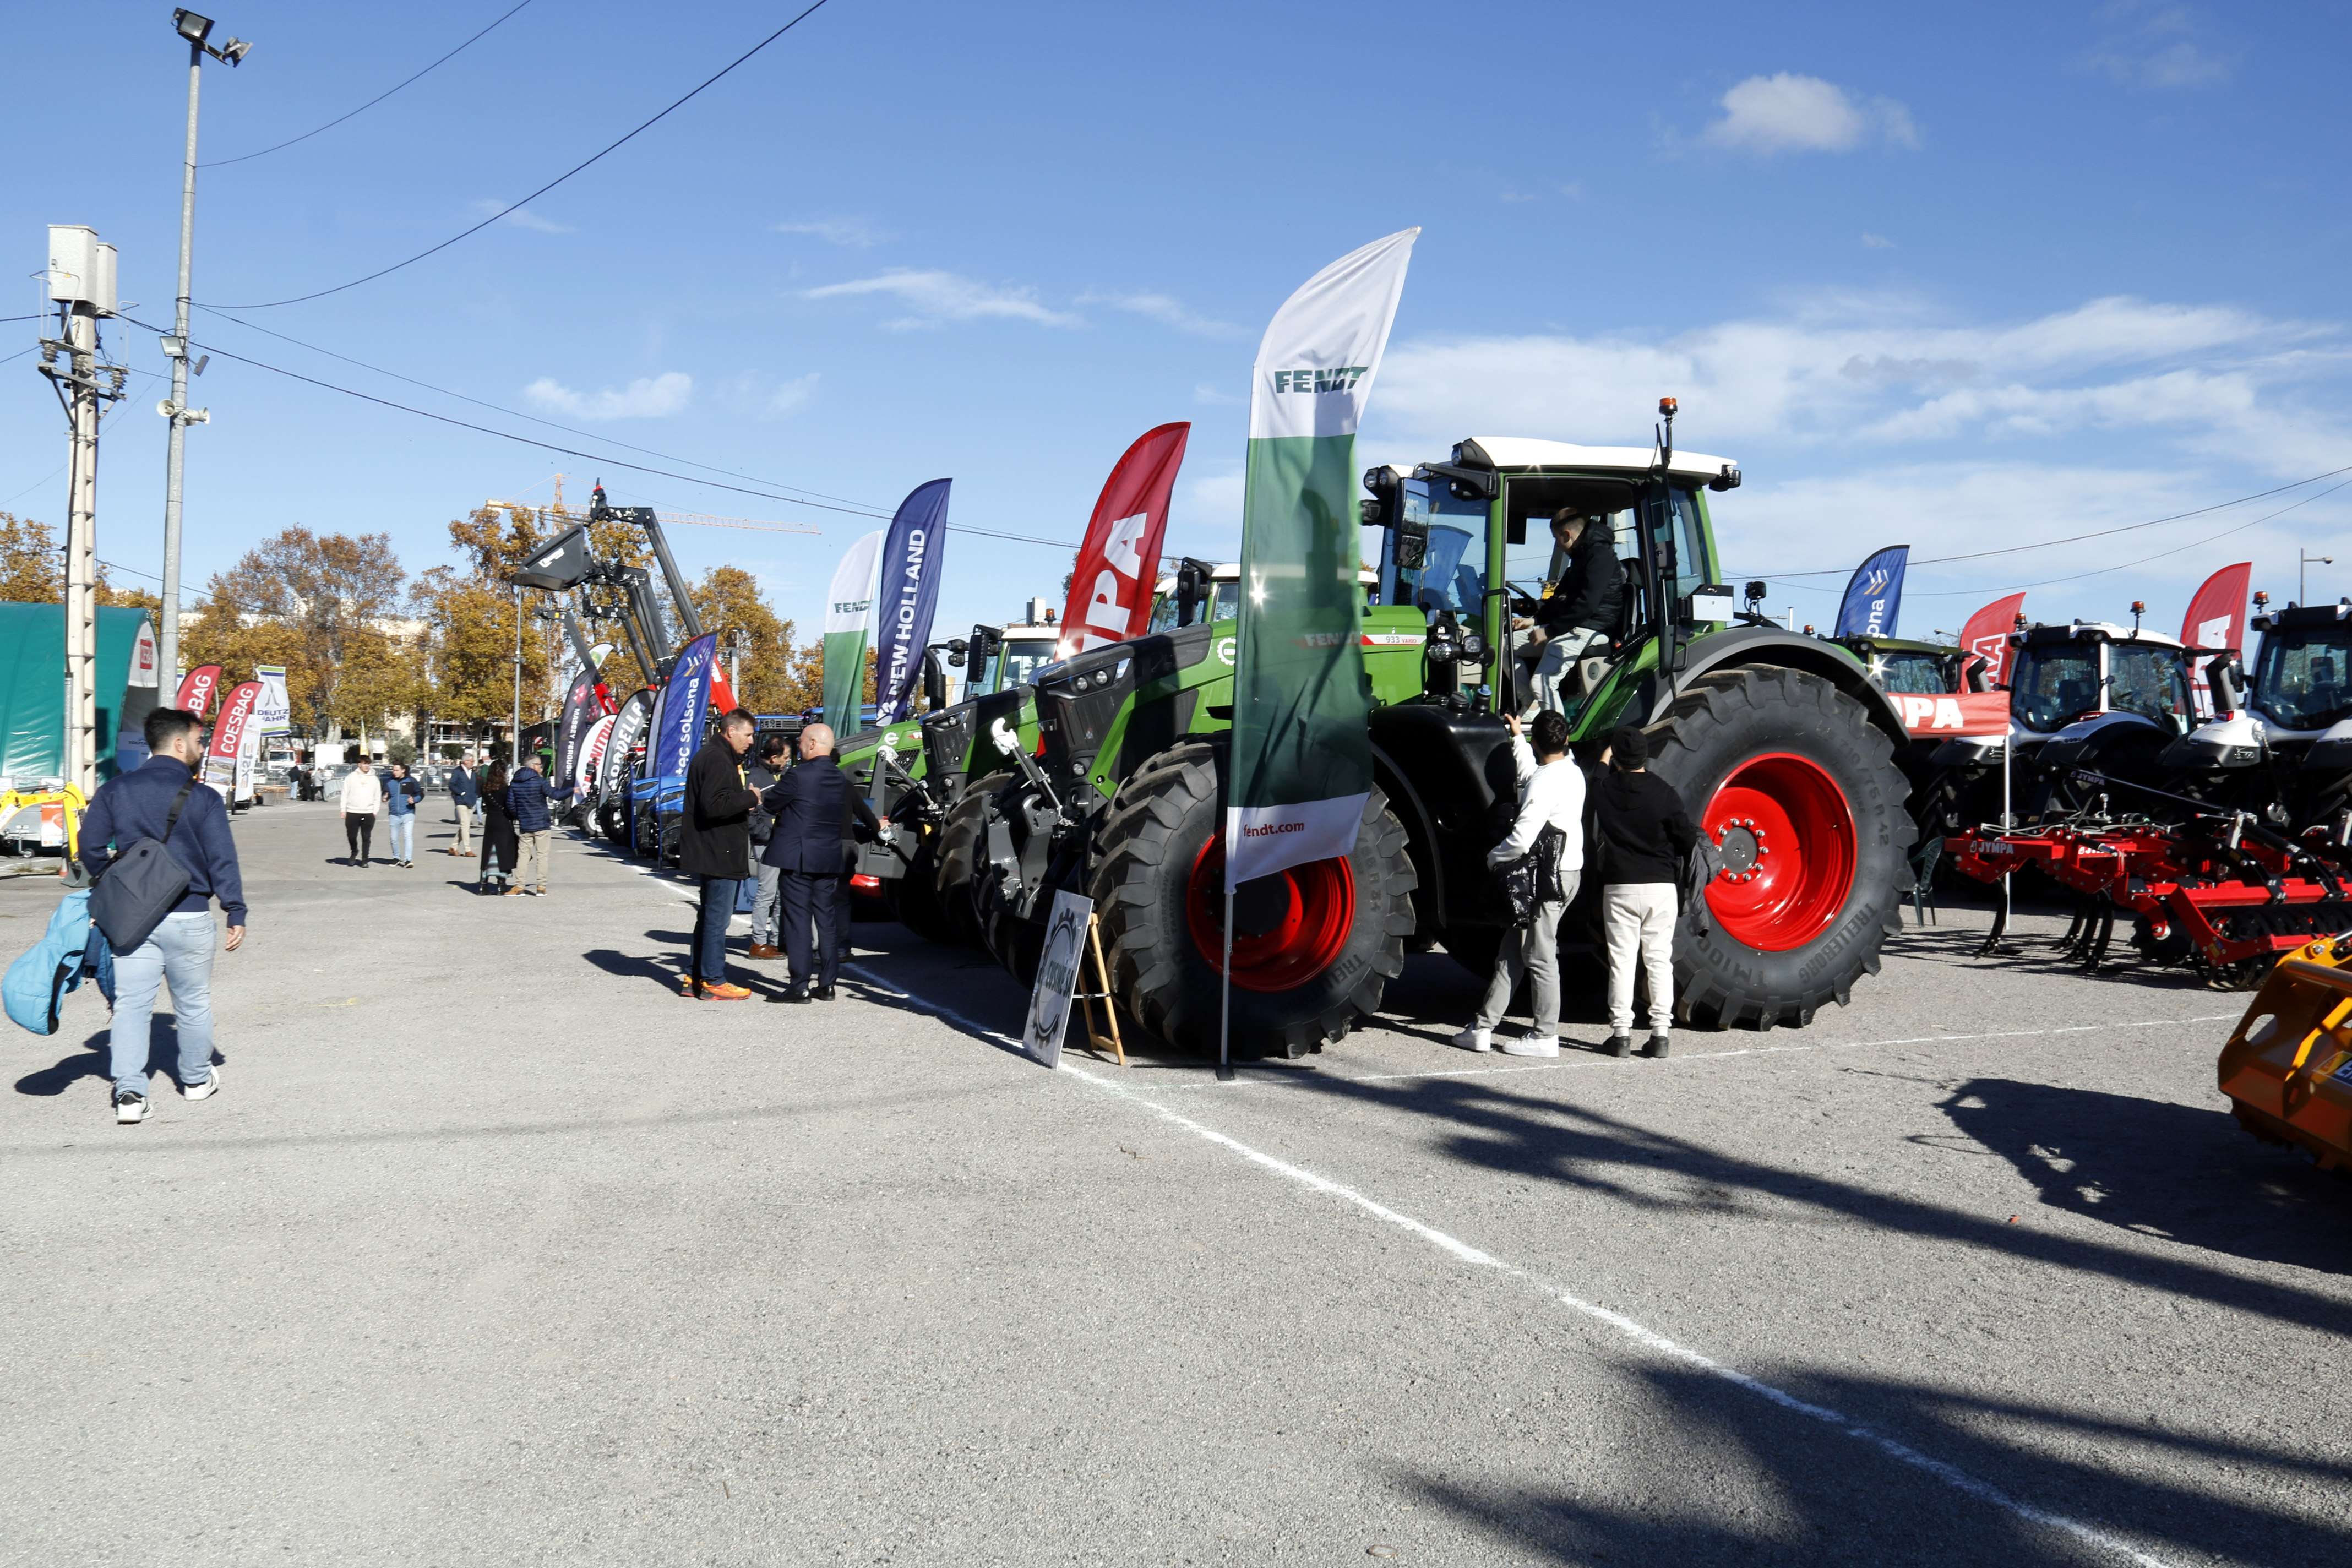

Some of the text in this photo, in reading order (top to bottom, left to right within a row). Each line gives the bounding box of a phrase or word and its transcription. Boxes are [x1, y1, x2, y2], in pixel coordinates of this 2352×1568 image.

[1274, 366, 1369, 393] FENDT
[889, 529, 925, 696] NEW HOLLAND
[188, 674, 211, 717] BAG
[221, 688, 254, 753] COESBAG
[680, 677, 700, 743] solsona
[565, 708, 580, 780] MASSEY FERGUSON
[2077, 773, 2105, 786] JYMPA
[1244, 822, 1305, 837] fendt.com
[1978, 842, 2014, 854] JYMPA
[1798, 903, 1878, 984] TRELLEBORG
